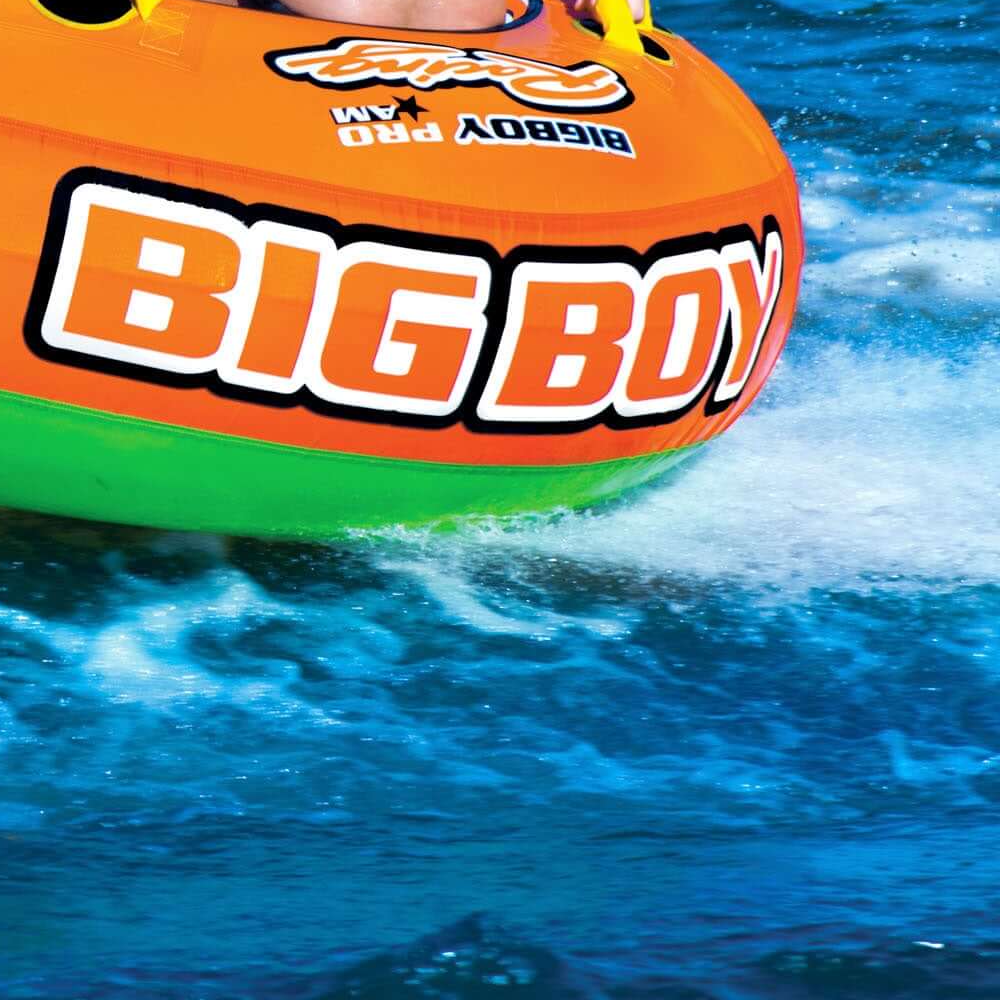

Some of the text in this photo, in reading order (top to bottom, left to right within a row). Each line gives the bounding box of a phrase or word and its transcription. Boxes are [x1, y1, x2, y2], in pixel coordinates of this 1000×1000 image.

[272, 39, 630, 108] Racing
[332, 106, 398, 124] AM
[337, 113, 637, 159] BIGBOY PRO
